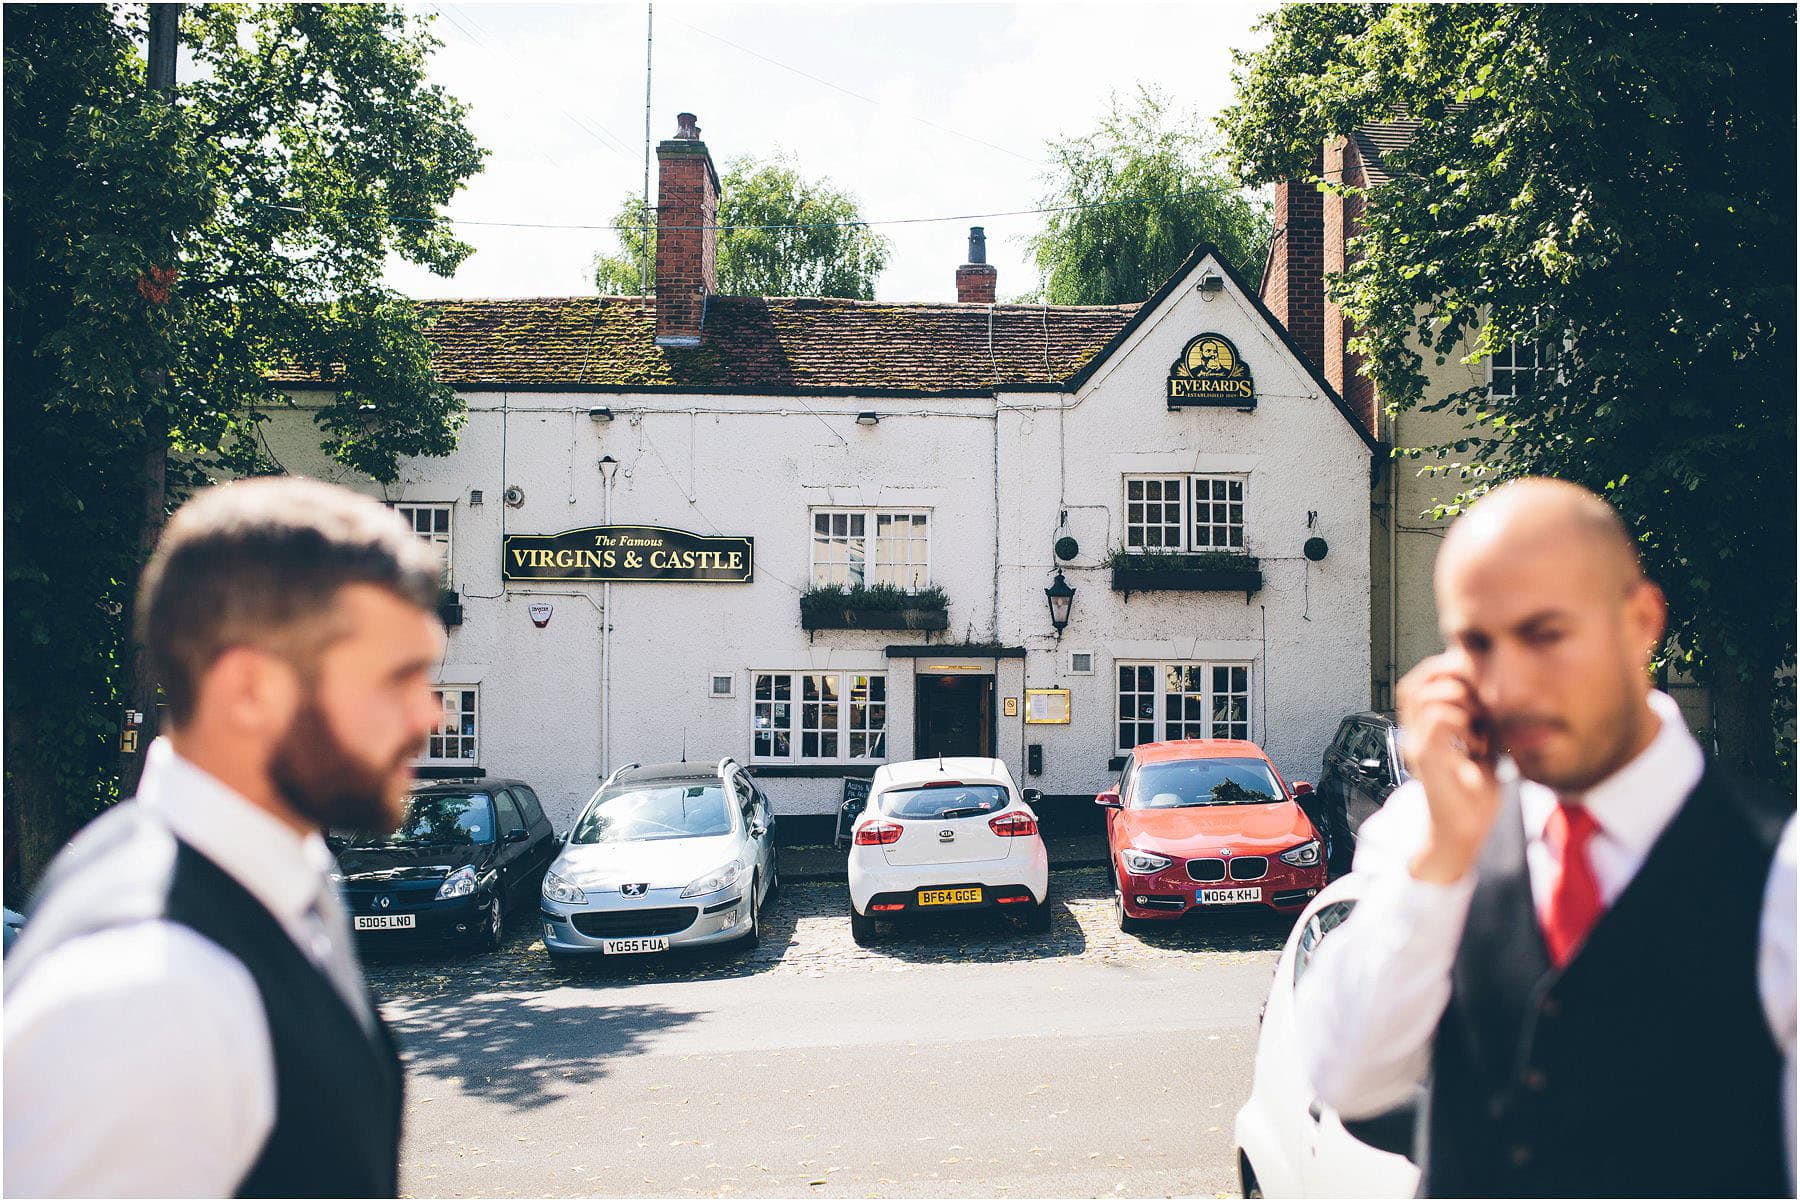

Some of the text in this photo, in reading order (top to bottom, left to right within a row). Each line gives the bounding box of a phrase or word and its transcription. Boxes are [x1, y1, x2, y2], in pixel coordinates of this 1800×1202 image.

[1171, 379, 1252, 398] EVERARDS
[595, 535, 664, 547] The Famous
[512, 549, 743, 570] VIRGINS & CASTLE
[923, 889, 977, 903] BF64 GGE
[1204, 888, 1260, 901] WO64 KHJ
[359, 916, 411, 927] SD05 LNO
[608, 939, 664, 953] YG55 FUA
